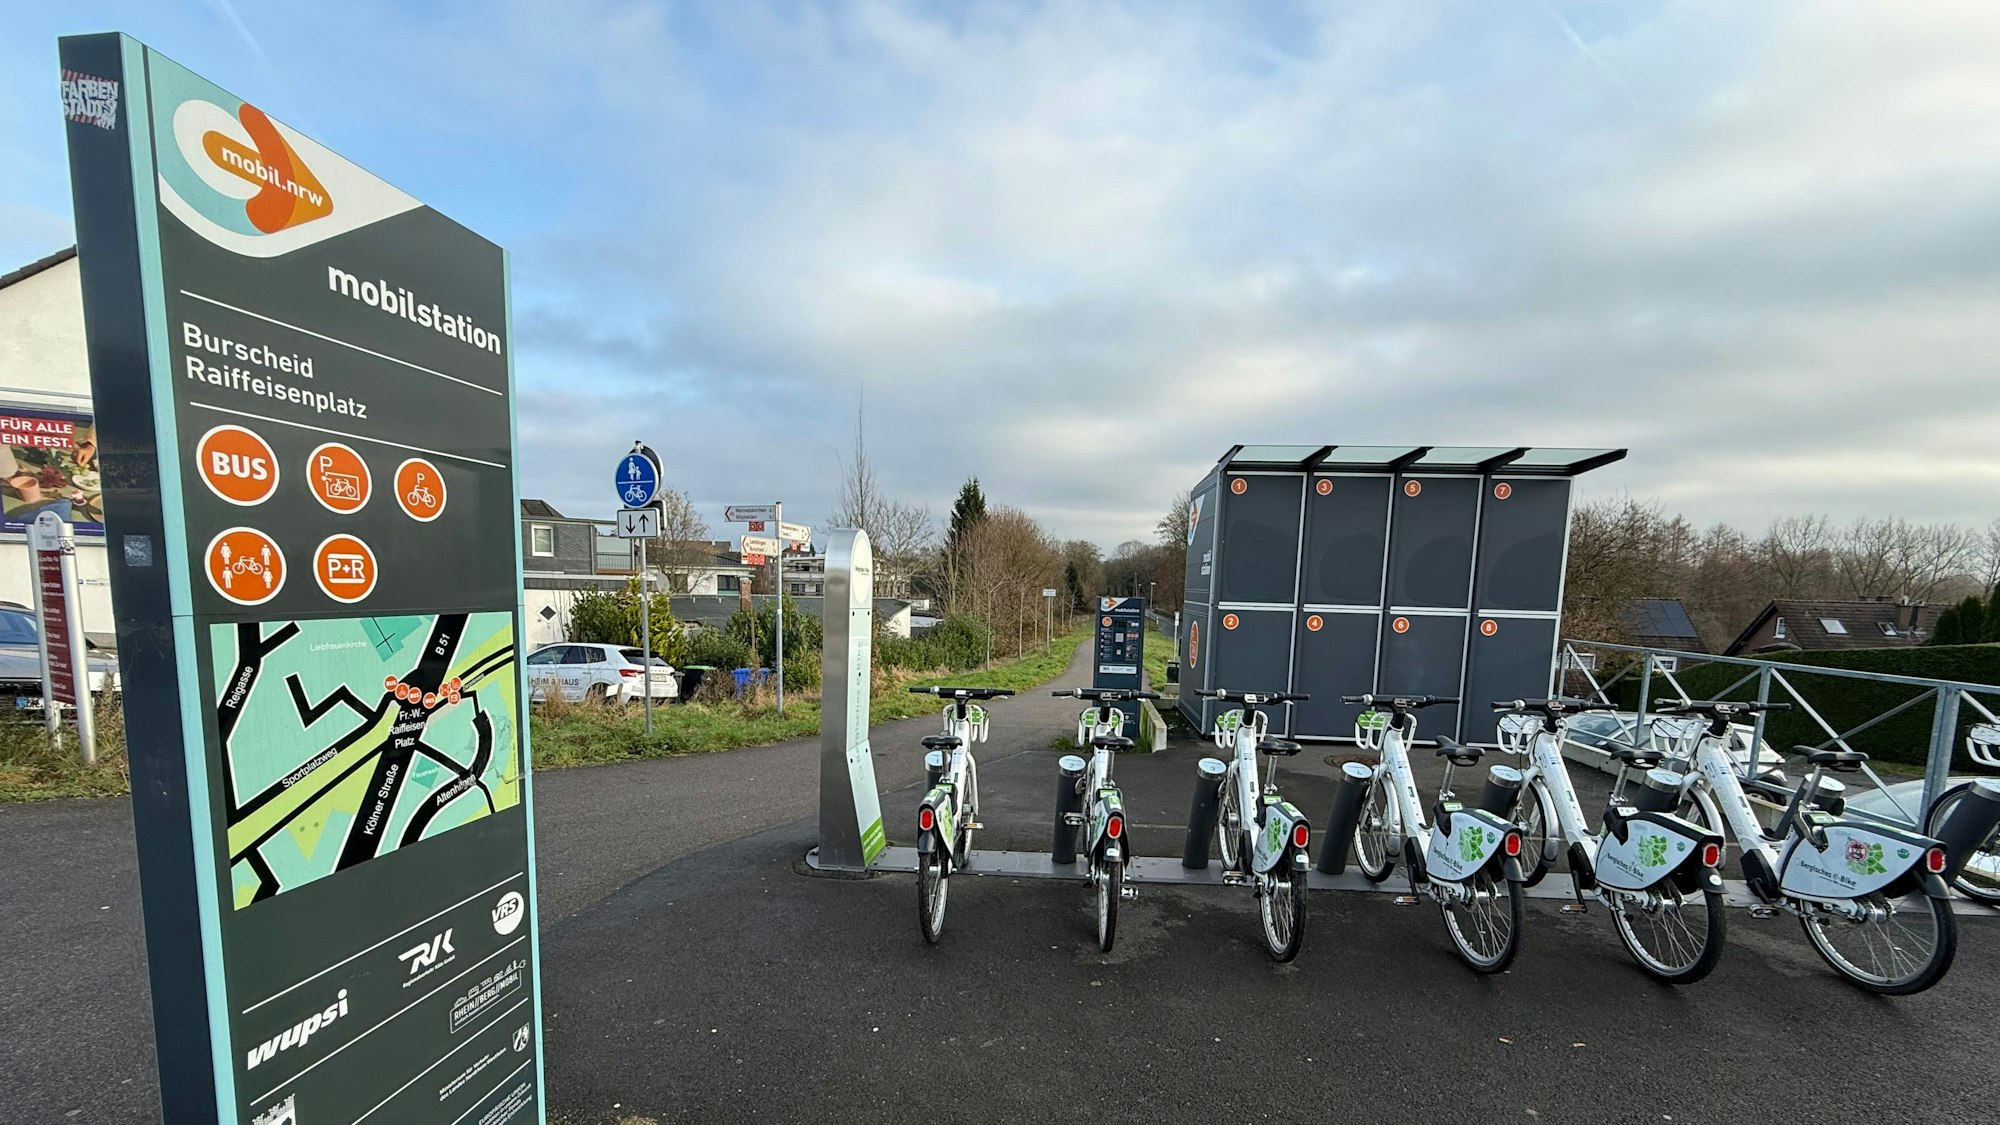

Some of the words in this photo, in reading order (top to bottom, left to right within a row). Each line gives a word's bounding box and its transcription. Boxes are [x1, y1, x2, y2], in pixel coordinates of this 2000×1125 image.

[62, 79, 118, 100] FARBEN
[222, 147, 323, 208] mobil.nrw
[328, 266, 501, 355] mobilstation
[183, 322, 314, 379] Burscheid
[186, 355, 367, 419] Raiffeisenplatz
[0, 416, 32, 431] FÜR
[36, 422, 73, 434] ALLE
[2, 433, 29, 445] EIN
[34, 436, 73, 448] FEST.
[211, 451, 268, 481] BUS
[319, 455, 333, 473] P
[416, 472, 425, 484] P
[328, 559, 366, 579] P+R
[310, 640, 367, 652] Liebfrauenkirche
[439, 633, 450, 647] 51
[435, 646, 445, 656] B
[225, 666, 254, 709] Reigasse
[559, 678, 579, 686] HAUS
[395, 737, 415, 749] Platz
[282, 747, 338, 788] Sportplatzweg
[364, 801, 385, 836] Kölner
[378, 763, 399, 799] Straße
[1800, 860, 1832, 878] Bergisches
[491, 898, 517, 923] VRS
[247, 988, 349, 1070] wupsi
